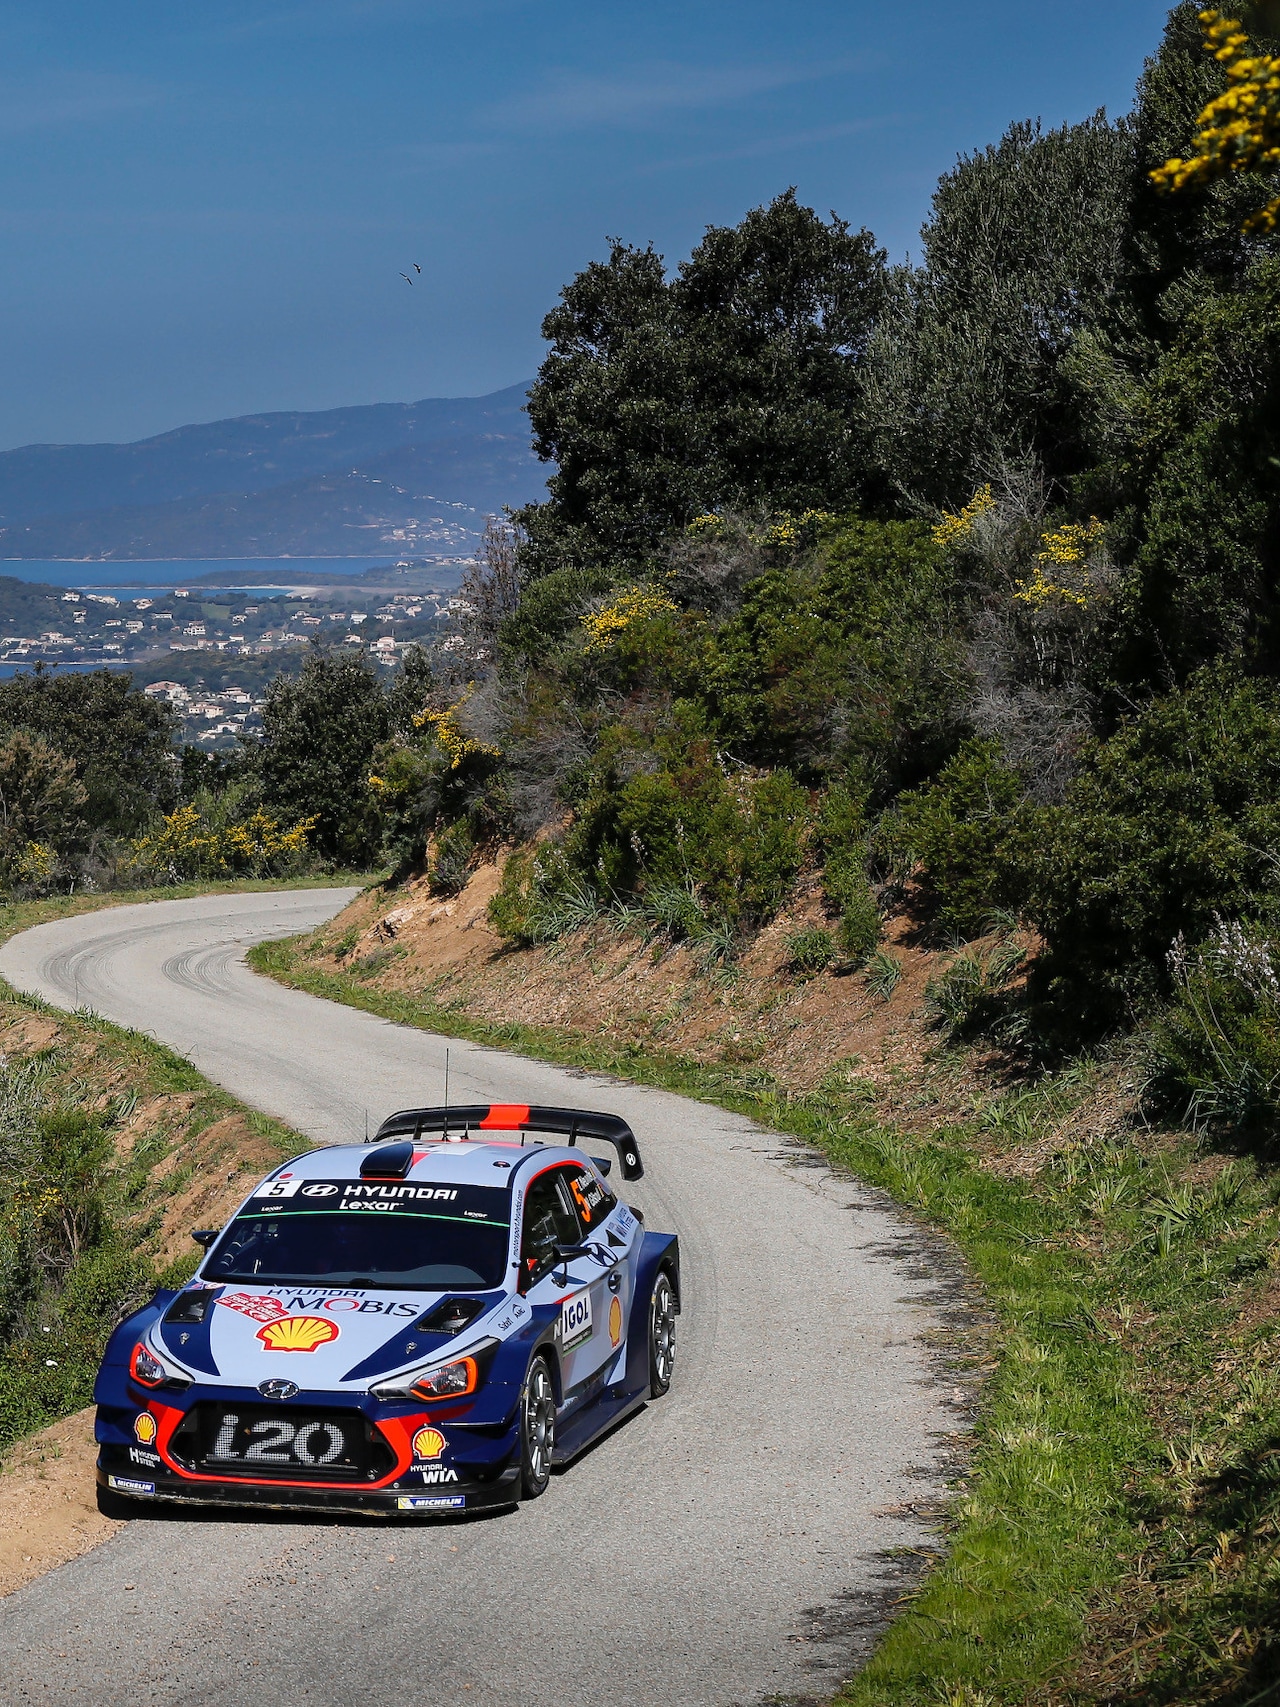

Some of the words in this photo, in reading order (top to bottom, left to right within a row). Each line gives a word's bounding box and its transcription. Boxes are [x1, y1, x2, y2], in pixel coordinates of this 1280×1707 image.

[268, 1182, 290, 1196] 5
[343, 1185, 458, 1200] HYUNDAI
[339, 1199, 404, 1211] Lexar
[570, 1179, 591, 1223] 5
[267, 1289, 366, 1298] HYUNDAI
[286, 1297, 420, 1317] MOBIS
[564, 1297, 589, 1334] IGOL
[214, 1414, 344, 1464] i20
[410, 1464, 443, 1472] HYUNDAI
[422, 1467, 459, 1484] WIA
[117, 1480, 153, 1491] MICHELIN
[415, 1498, 463, 1506] MICHELIN
